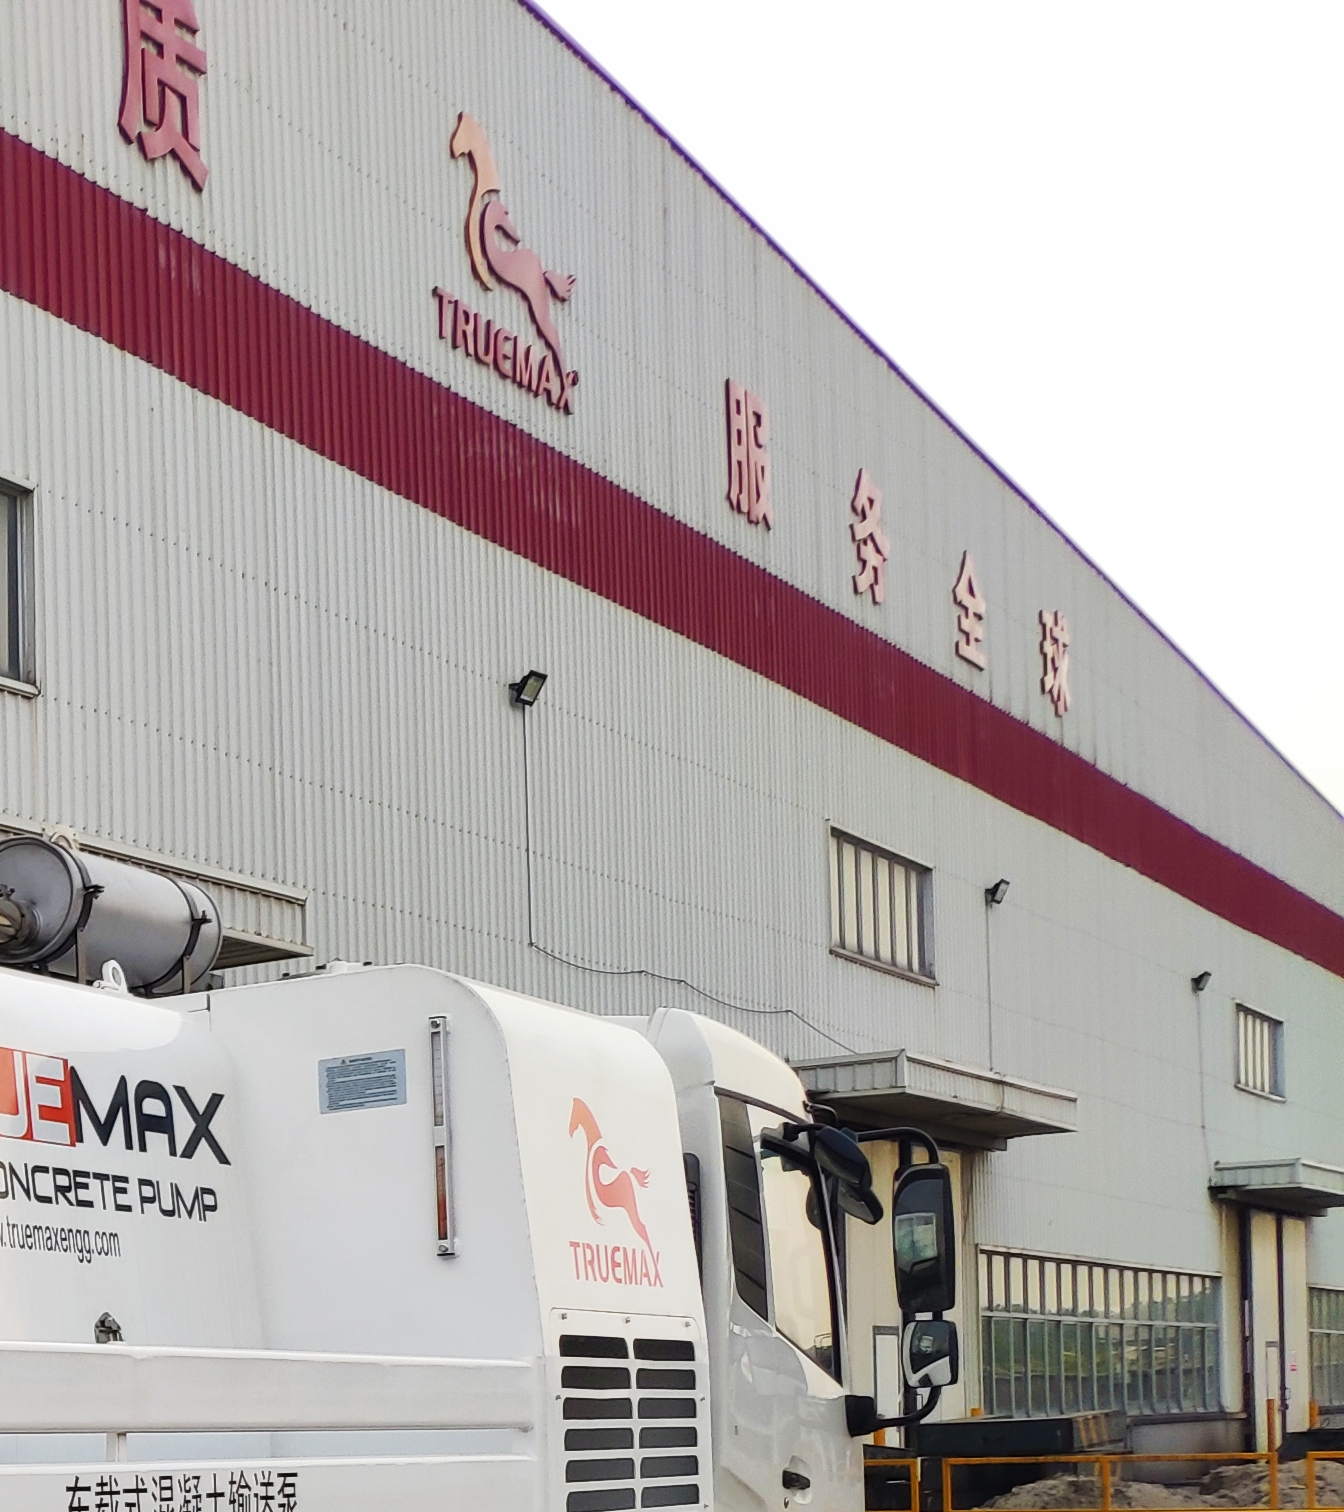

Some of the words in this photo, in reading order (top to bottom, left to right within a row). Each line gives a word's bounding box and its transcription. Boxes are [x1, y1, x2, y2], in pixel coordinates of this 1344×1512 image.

[117, 0, 209, 192] 质
[432, 285, 575, 415] TRUEMAX
[725, 377, 1072, 718] 服务全球
[137, 1178, 218, 1222] PUMP
[569, 1241, 664, 1288] TRUEMAX
